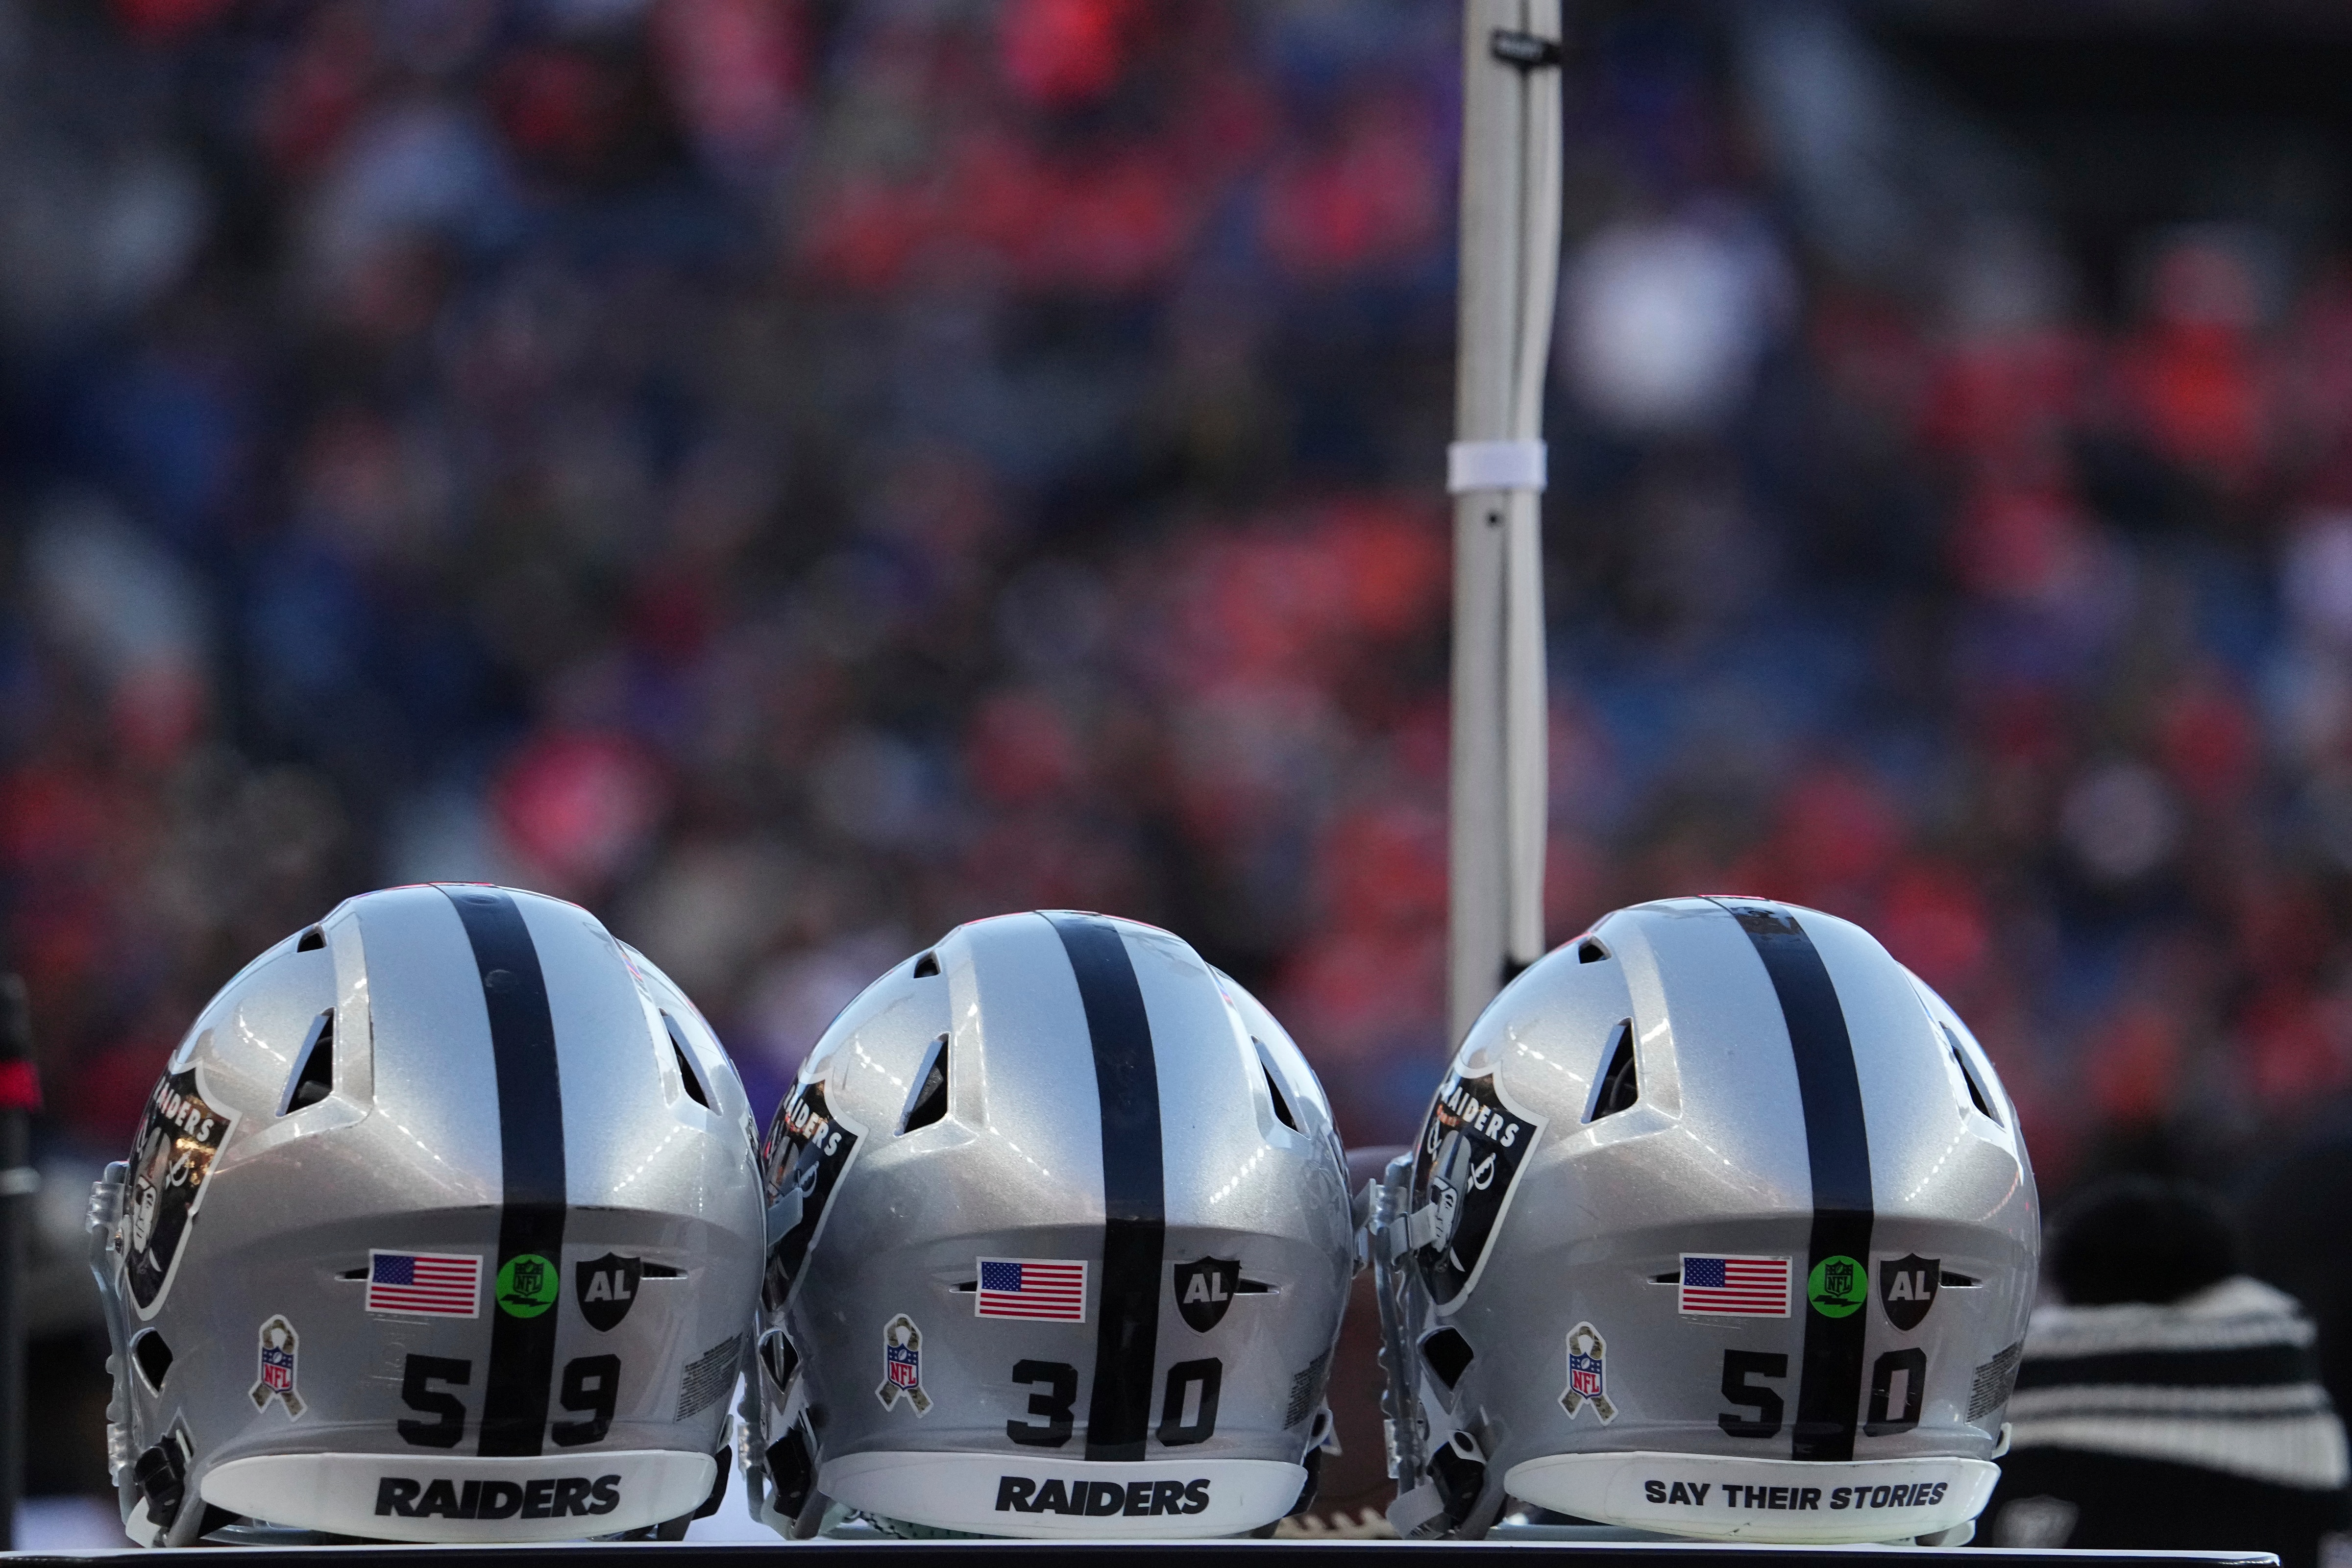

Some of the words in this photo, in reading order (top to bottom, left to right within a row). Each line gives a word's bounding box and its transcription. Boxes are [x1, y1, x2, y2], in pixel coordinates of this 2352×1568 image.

[516, 1274, 541, 1292] NFL
[586, 1270, 631, 1301] AL
[1183, 1272, 1228, 1303] AL
[1828, 1276, 1851, 1293] NFL
[1887, 1270, 1931, 1301] AL
[265, 1364, 291, 1388] NFL
[890, 1361, 916, 1386] NFL
[1573, 1370, 1599, 1394] NFL
[374, 1474, 621, 1520] RAIDERS
[995, 1476, 1211, 1517] RAIDERS
[1644, 1480, 1711, 1506] SAY
[1722, 1484, 1822, 1510] THEIR
[1830, 1482, 1948, 1510] STORIES
